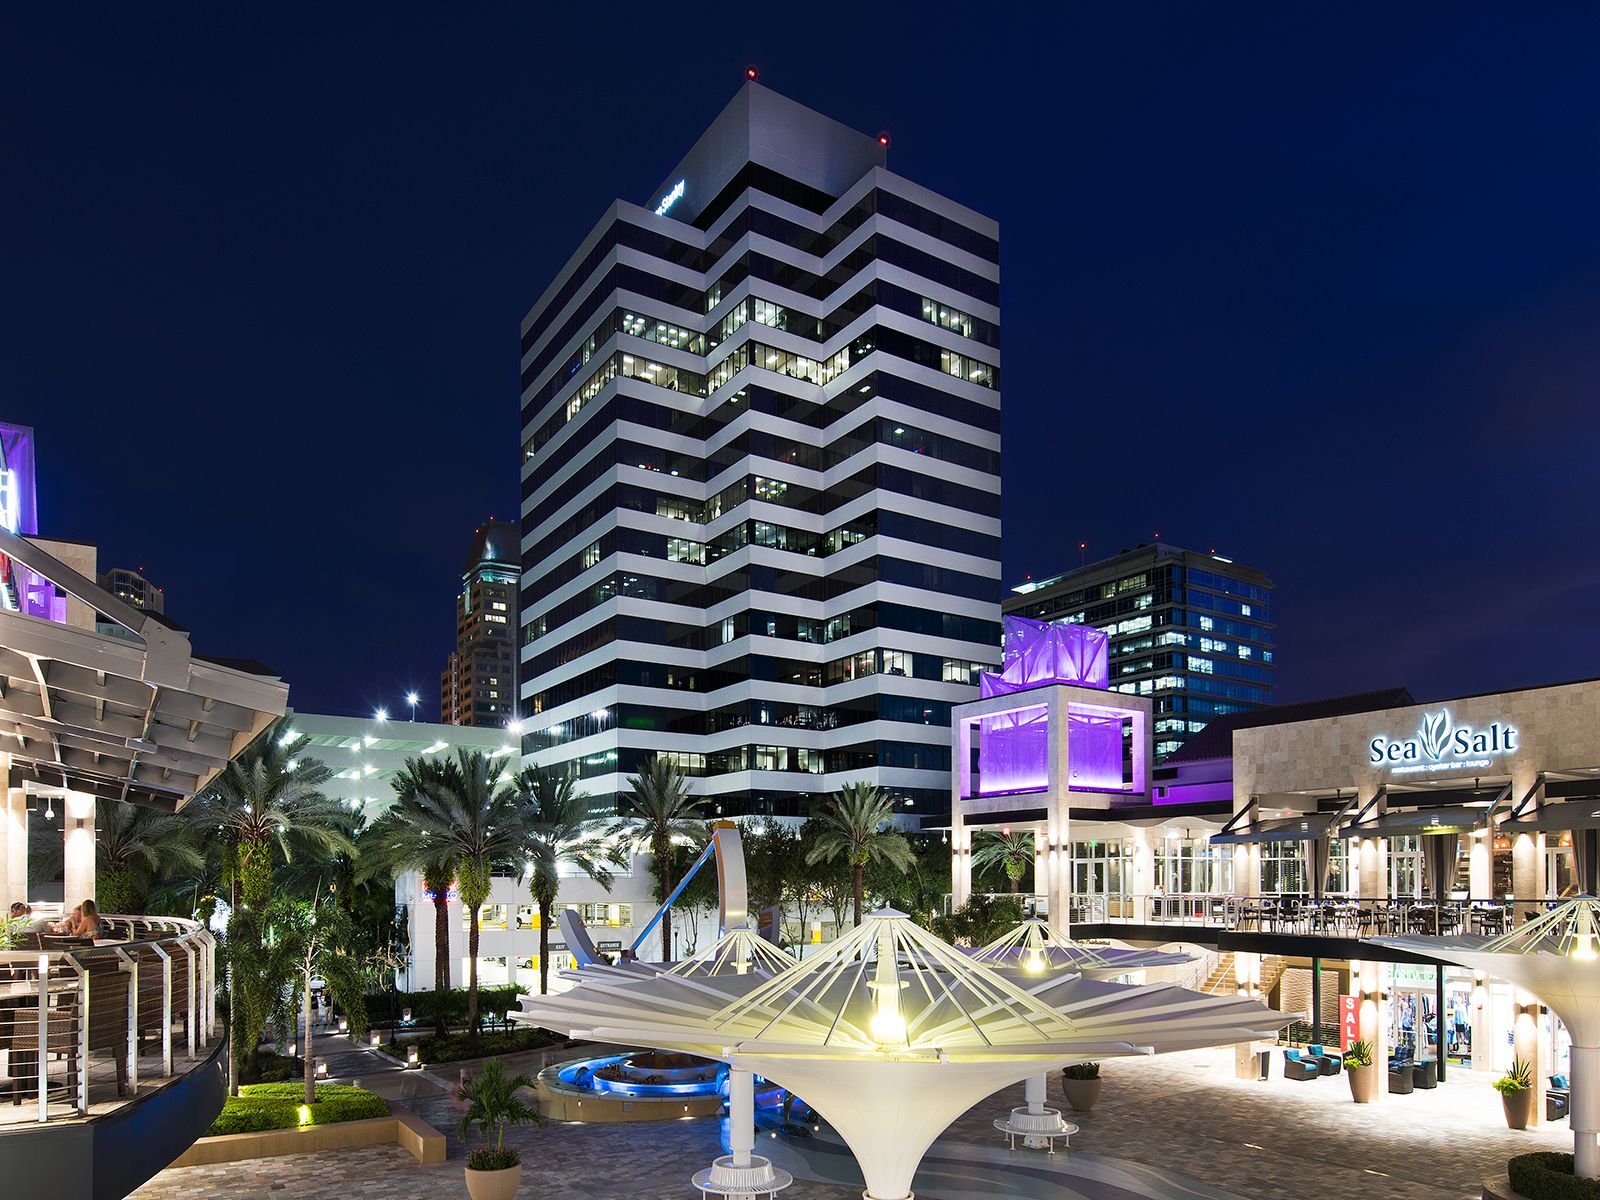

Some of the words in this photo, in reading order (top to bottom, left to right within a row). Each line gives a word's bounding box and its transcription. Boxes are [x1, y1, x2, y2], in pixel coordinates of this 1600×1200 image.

[1370, 738, 1417, 762] Sea
[1454, 724, 1516, 754] Salt
[1466, 759, 1489, 768] lounge
